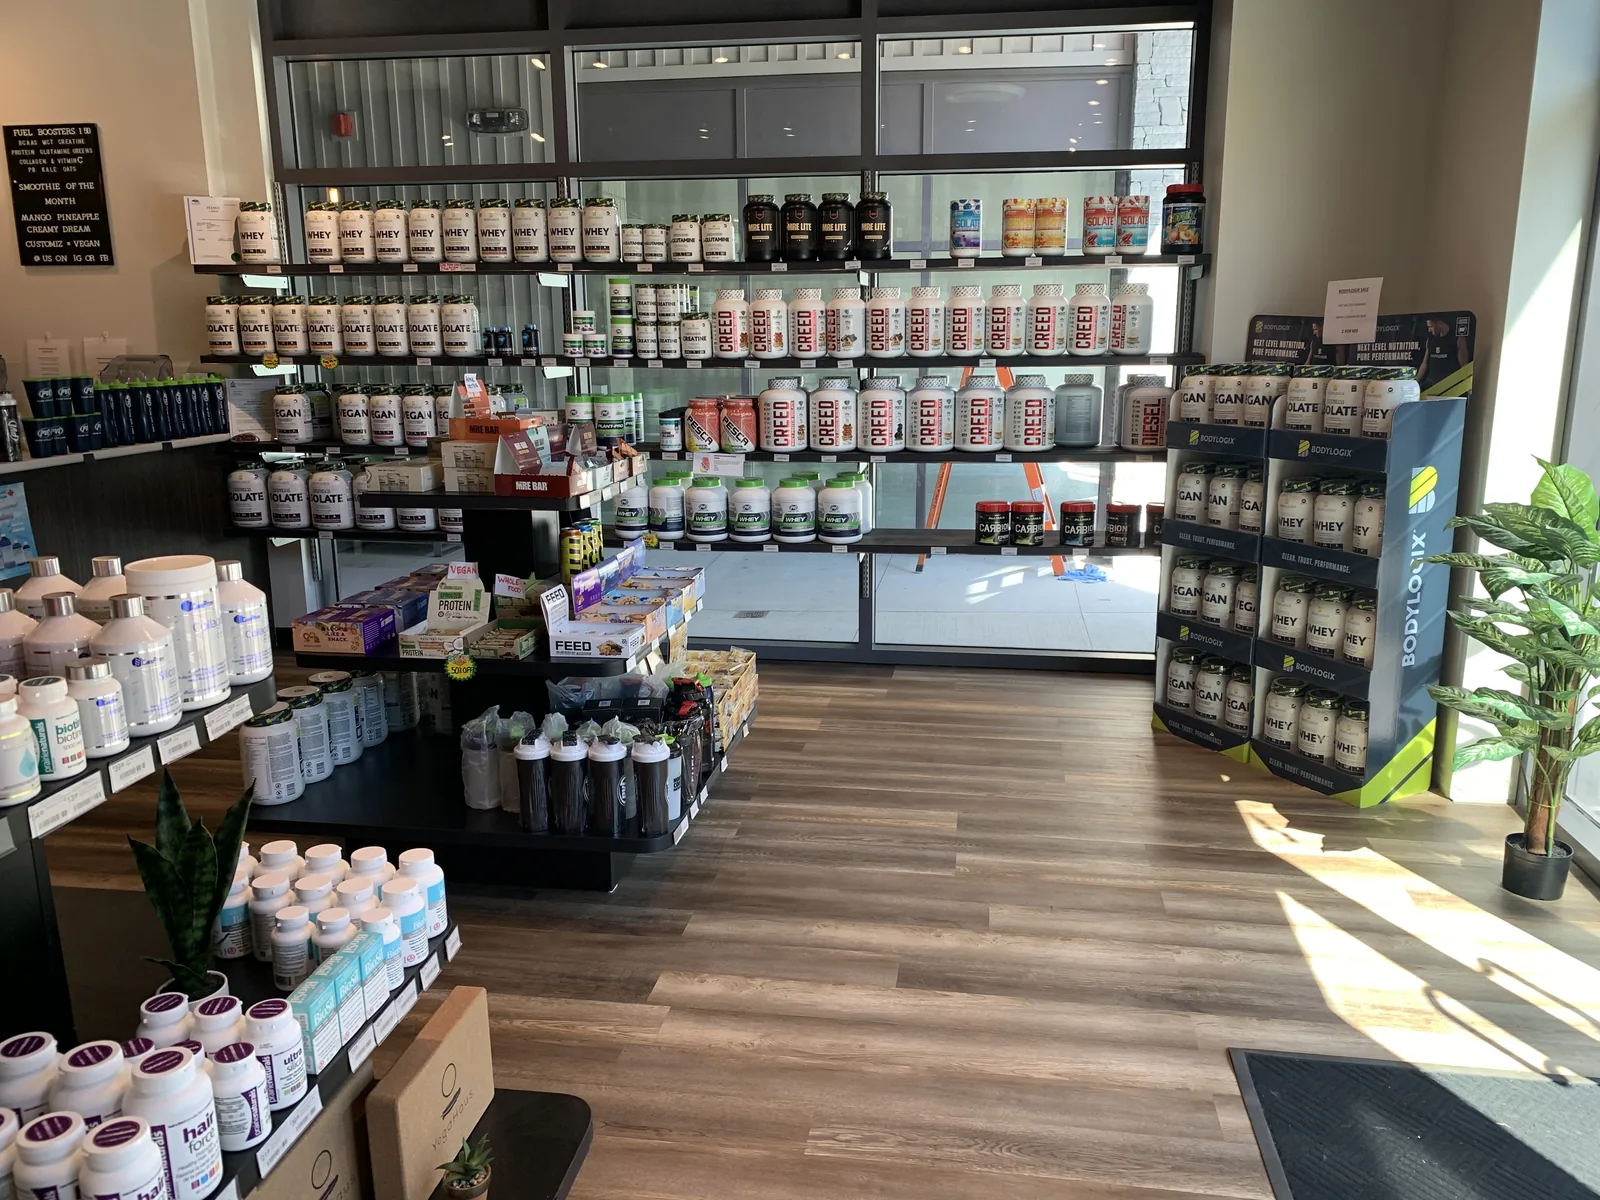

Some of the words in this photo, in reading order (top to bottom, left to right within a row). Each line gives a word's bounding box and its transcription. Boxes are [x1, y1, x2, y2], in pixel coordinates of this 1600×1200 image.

[57, 213, 99, 221] PINEAPPLE
[444, 229, 468, 237] WHEY
[481, 229, 505, 237] WHEY
[550, 228, 574, 236] WHEY
[584, 228, 609, 236] WHEY
[748, 223, 760, 232] MRE
[761, 223, 773, 232] LITE
[788, 223, 799, 231] MRE
[800, 223, 812, 231] LITE
[822, 223, 834, 232] MRE
[835, 223, 846, 232] LITE
[862, 223, 874, 231] MRE
[874, 223, 886, 231] LITE
[718, 311, 733, 352] CREED
[752, 310, 767, 352] CREED
[797, 310, 812, 352] CREED
[871, 309, 884, 351] CREED
[910, 308, 924, 350] CREED
[952, 308, 967, 350] CREED
[991, 307, 1006, 350] CREED
[1034, 307, 1050, 350] CREED
[1076, 306, 1093, 349] CREED
[1254, 339, 1265, 347] NEXT
[1357, 344, 1371, 352] NEXT
[1372, 343, 1387, 351] LEVEL
[1388, 342, 1420, 352] NUTRITION,
[1252, 348, 1264, 356] PURE
[1357, 353, 1368, 361] PURE
[1370, 352, 1413, 361] PERFORMANCE.
[469, 425, 484, 433] MRE
[485, 426, 499, 434] BAR
[773, 401, 790, 447] CREED
[818, 400, 834, 446] CREED
[871, 400, 888, 446] CREED
[920, 399, 937, 446] CREED
[970, 398, 989, 445] CREED
[1024, 399, 1043, 446] CREED
[1142, 398, 1161, 446] DIESEL
[686, 415, 713, 446] PESCA
[722, 415, 749, 446] PESCA
[1200, 435, 1234, 444] BODYLOGIX
[1311, 445, 1352, 457] BODYLOGIX
[516, 482, 531, 490] MRE
[532, 482, 548, 491] BAR
[1015, 523, 1044, 532] CARBIO
[1064, 524, 1095, 534] CARBIO
[450, 566, 477, 574] VEGAN
[1314, 560, 1350, 573] PERFORMANCE.
[498, 576, 520, 585] WHOLE
[508, 585, 521, 594] FOOD
[545, 588, 564, 604] FEED
[438, 600, 472, 611] PROTEIN
[555, 640, 592, 651] FEED
[1190, 632, 1223, 647] BODYLOGIX
[1296, 662, 1335, 680] BODYLOGIX
[39, 722, 53, 772] prairienaturals
[365, 948, 384, 975] BioSil
[340, 969, 359, 998] BioSil
[314, 995, 335, 1026] BioSil
[249, 1089, 262, 1137] prairienaturals
[183, 1111, 213, 1143] hair
[189, 1128, 214, 1154] force
